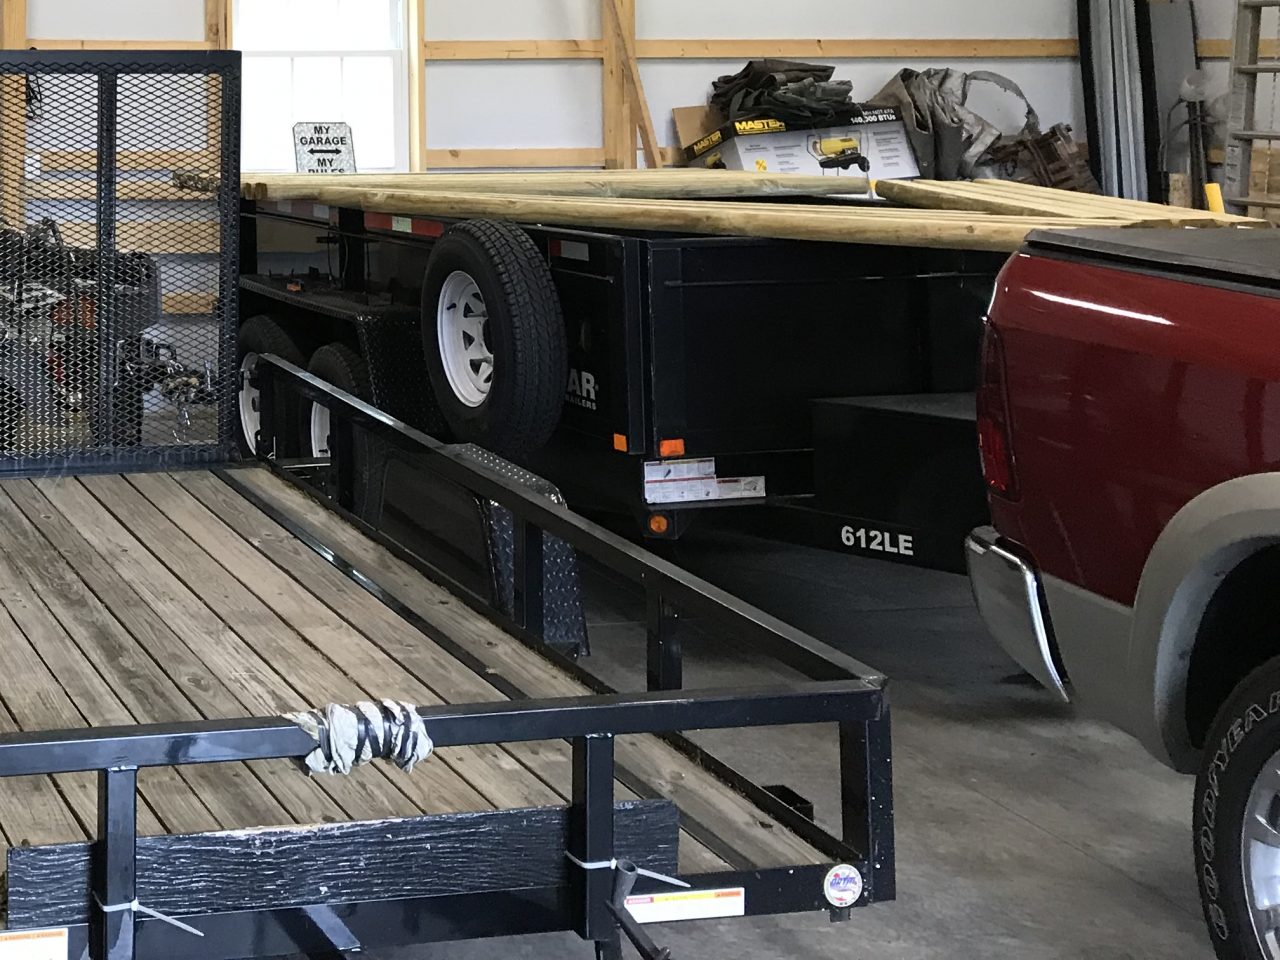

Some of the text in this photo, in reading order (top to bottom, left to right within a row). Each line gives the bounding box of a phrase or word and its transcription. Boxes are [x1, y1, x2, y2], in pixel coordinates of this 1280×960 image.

[313, 125, 330, 135] MY
[299, 136, 347, 146] GARAGE
[317, 158, 334, 168] MY
[567, 368, 596, 400] AR
[841, 525, 914, 556] 612LE
